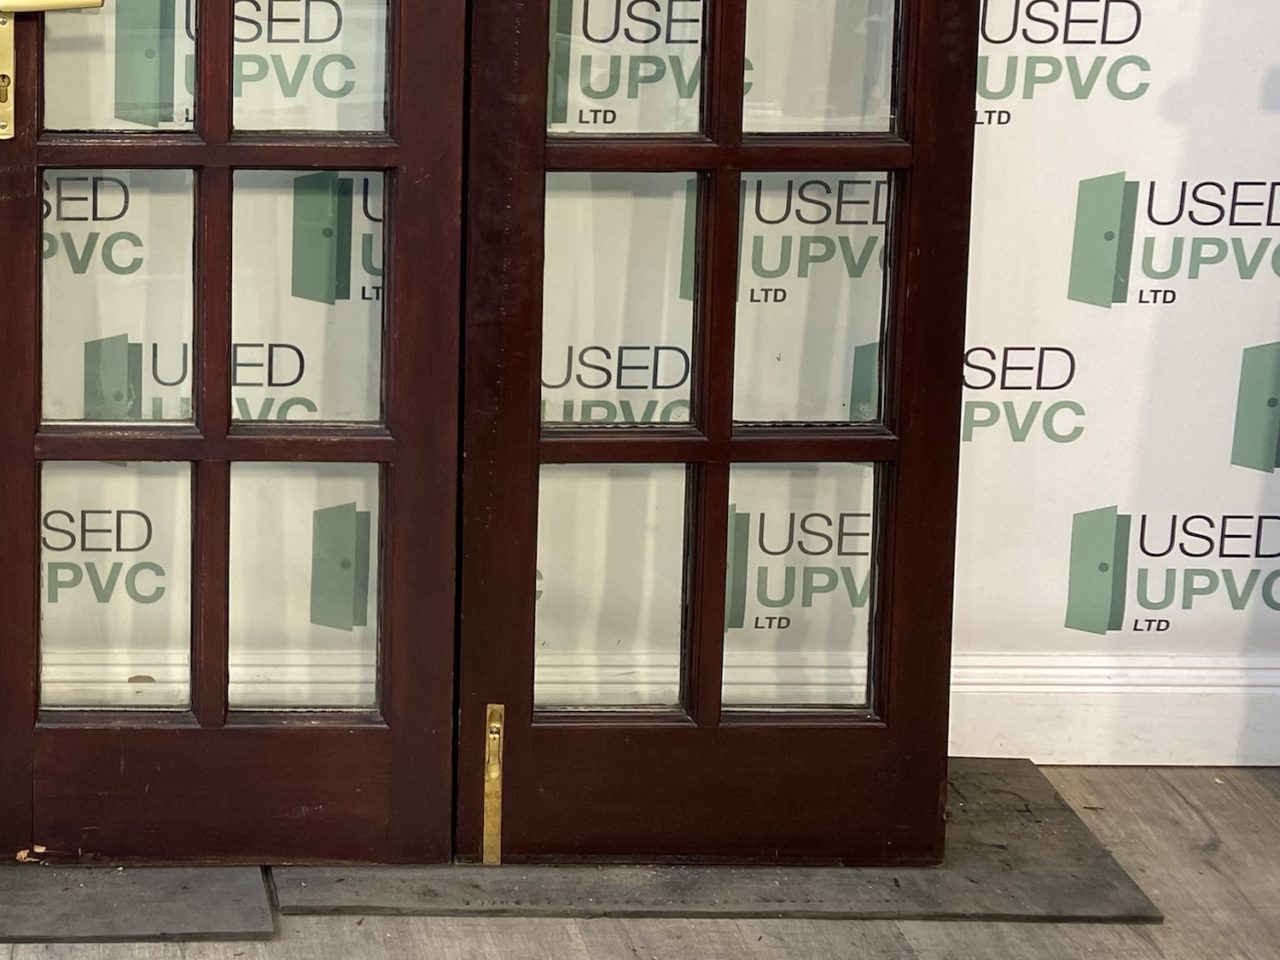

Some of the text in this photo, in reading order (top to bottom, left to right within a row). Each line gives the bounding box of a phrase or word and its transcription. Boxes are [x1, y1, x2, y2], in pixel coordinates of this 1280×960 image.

[977, 55, 1152, 101] UPVC
[578, 109, 616, 125] LTD
[750, 235, 884, 279] UPV
[1141, 237, 1280, 280] UPV
[361, 286, 382, 301] LT
[749, 288, 787, 303] LTD
[1138, 290, 1176, 304] LTD
[962, 347, 1076, 390] SED
[962, 400, 1086, 443] PVC
[42, 510, 153, 552] SED
[758, 512, 871, 556] USE
[42, 562, 166, 604] PVC
[756, 566, 869, 608] UPV
[754, 616, 791, 630] LTD
[1133, 619, 1170, 632] LTD
